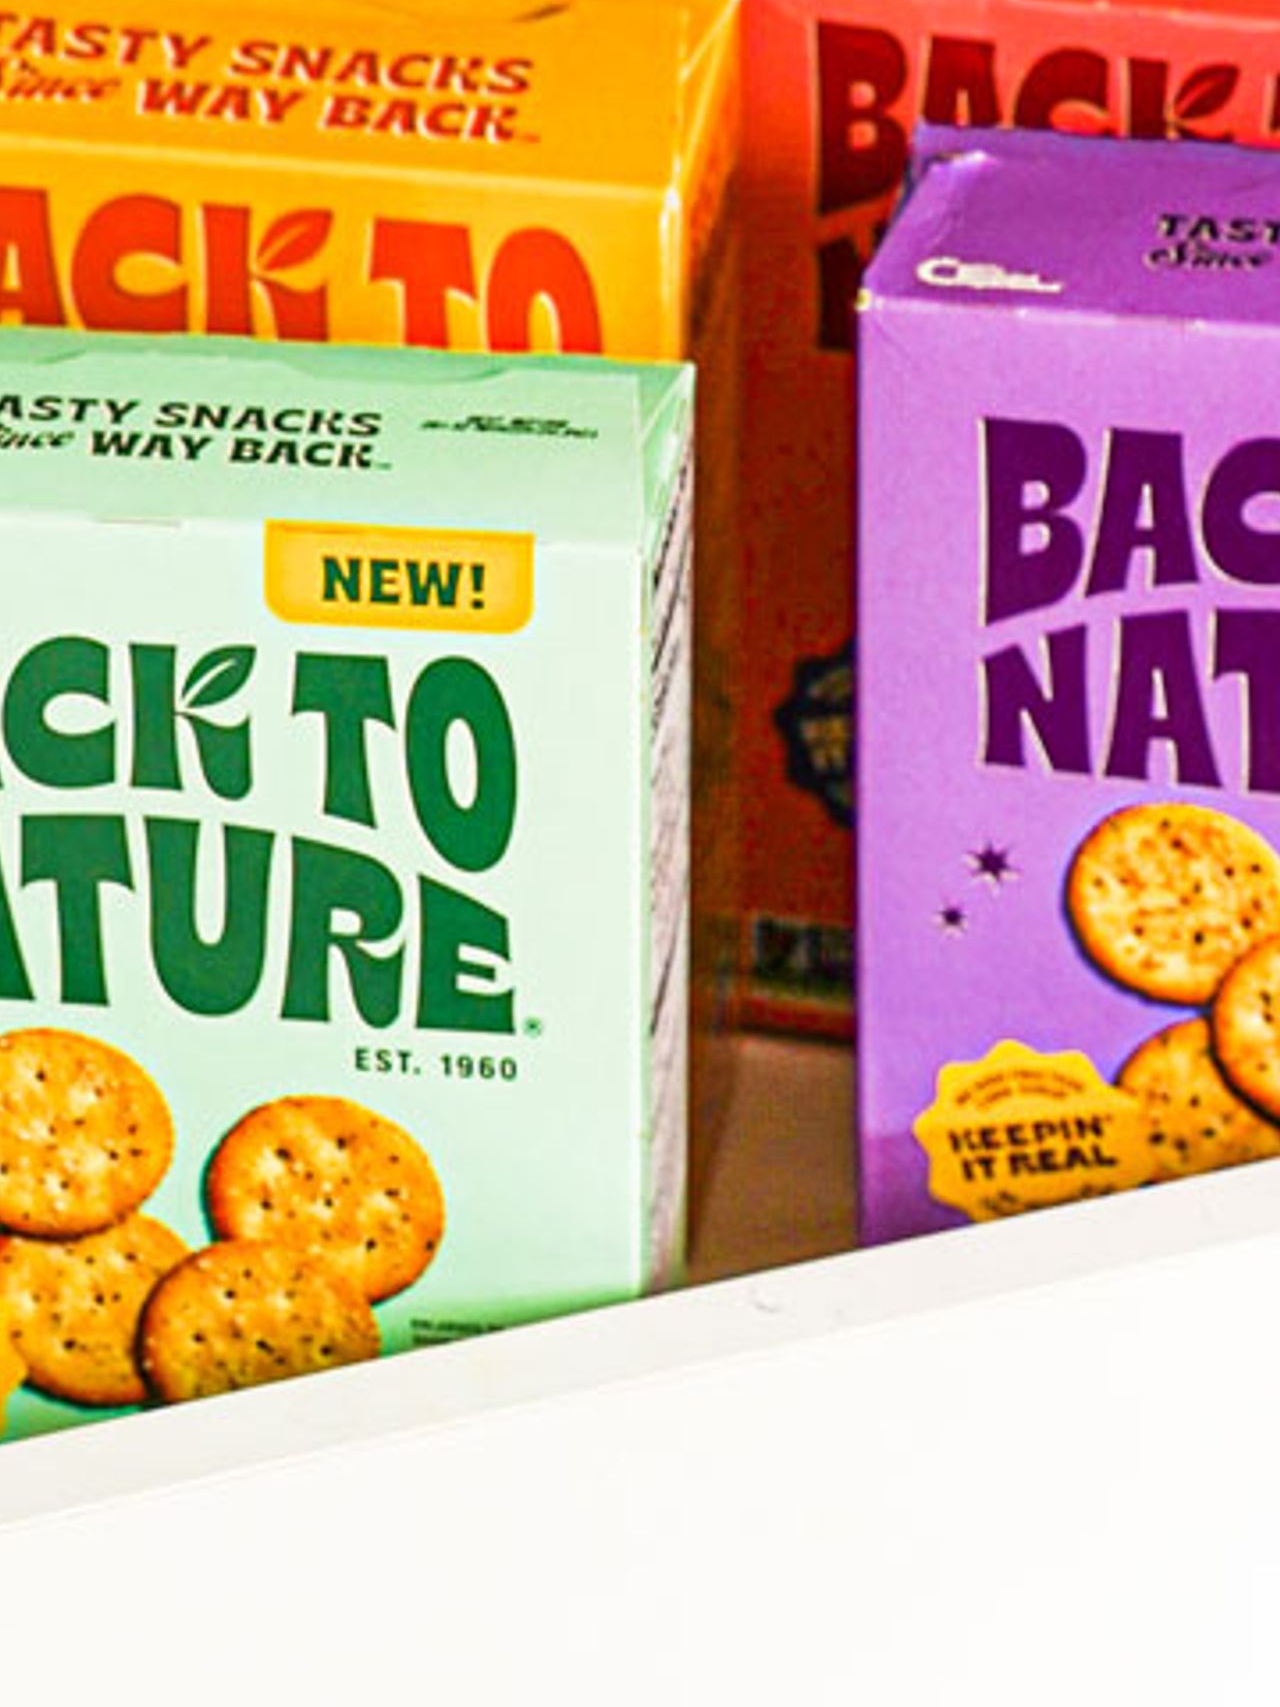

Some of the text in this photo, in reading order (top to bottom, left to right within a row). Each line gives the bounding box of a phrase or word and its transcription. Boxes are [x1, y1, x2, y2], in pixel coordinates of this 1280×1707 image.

[229, 41, 532, 95] SNACKS
[134, 78, 307, 126] WAY
[368, 217, 603, 354] TO
[153, 401, 383, 437] SNACKS
[89, 431, 214, 461] WAY
[320, 554, 488, 610] NEW!
[290, 651, 518, 874] TO
[355, 1047, 519, 1081] EST. 1960
[948, 1114, 1113, 1153] KEEPIN'
[962, 1145, 1118, 1182] IT REAL
